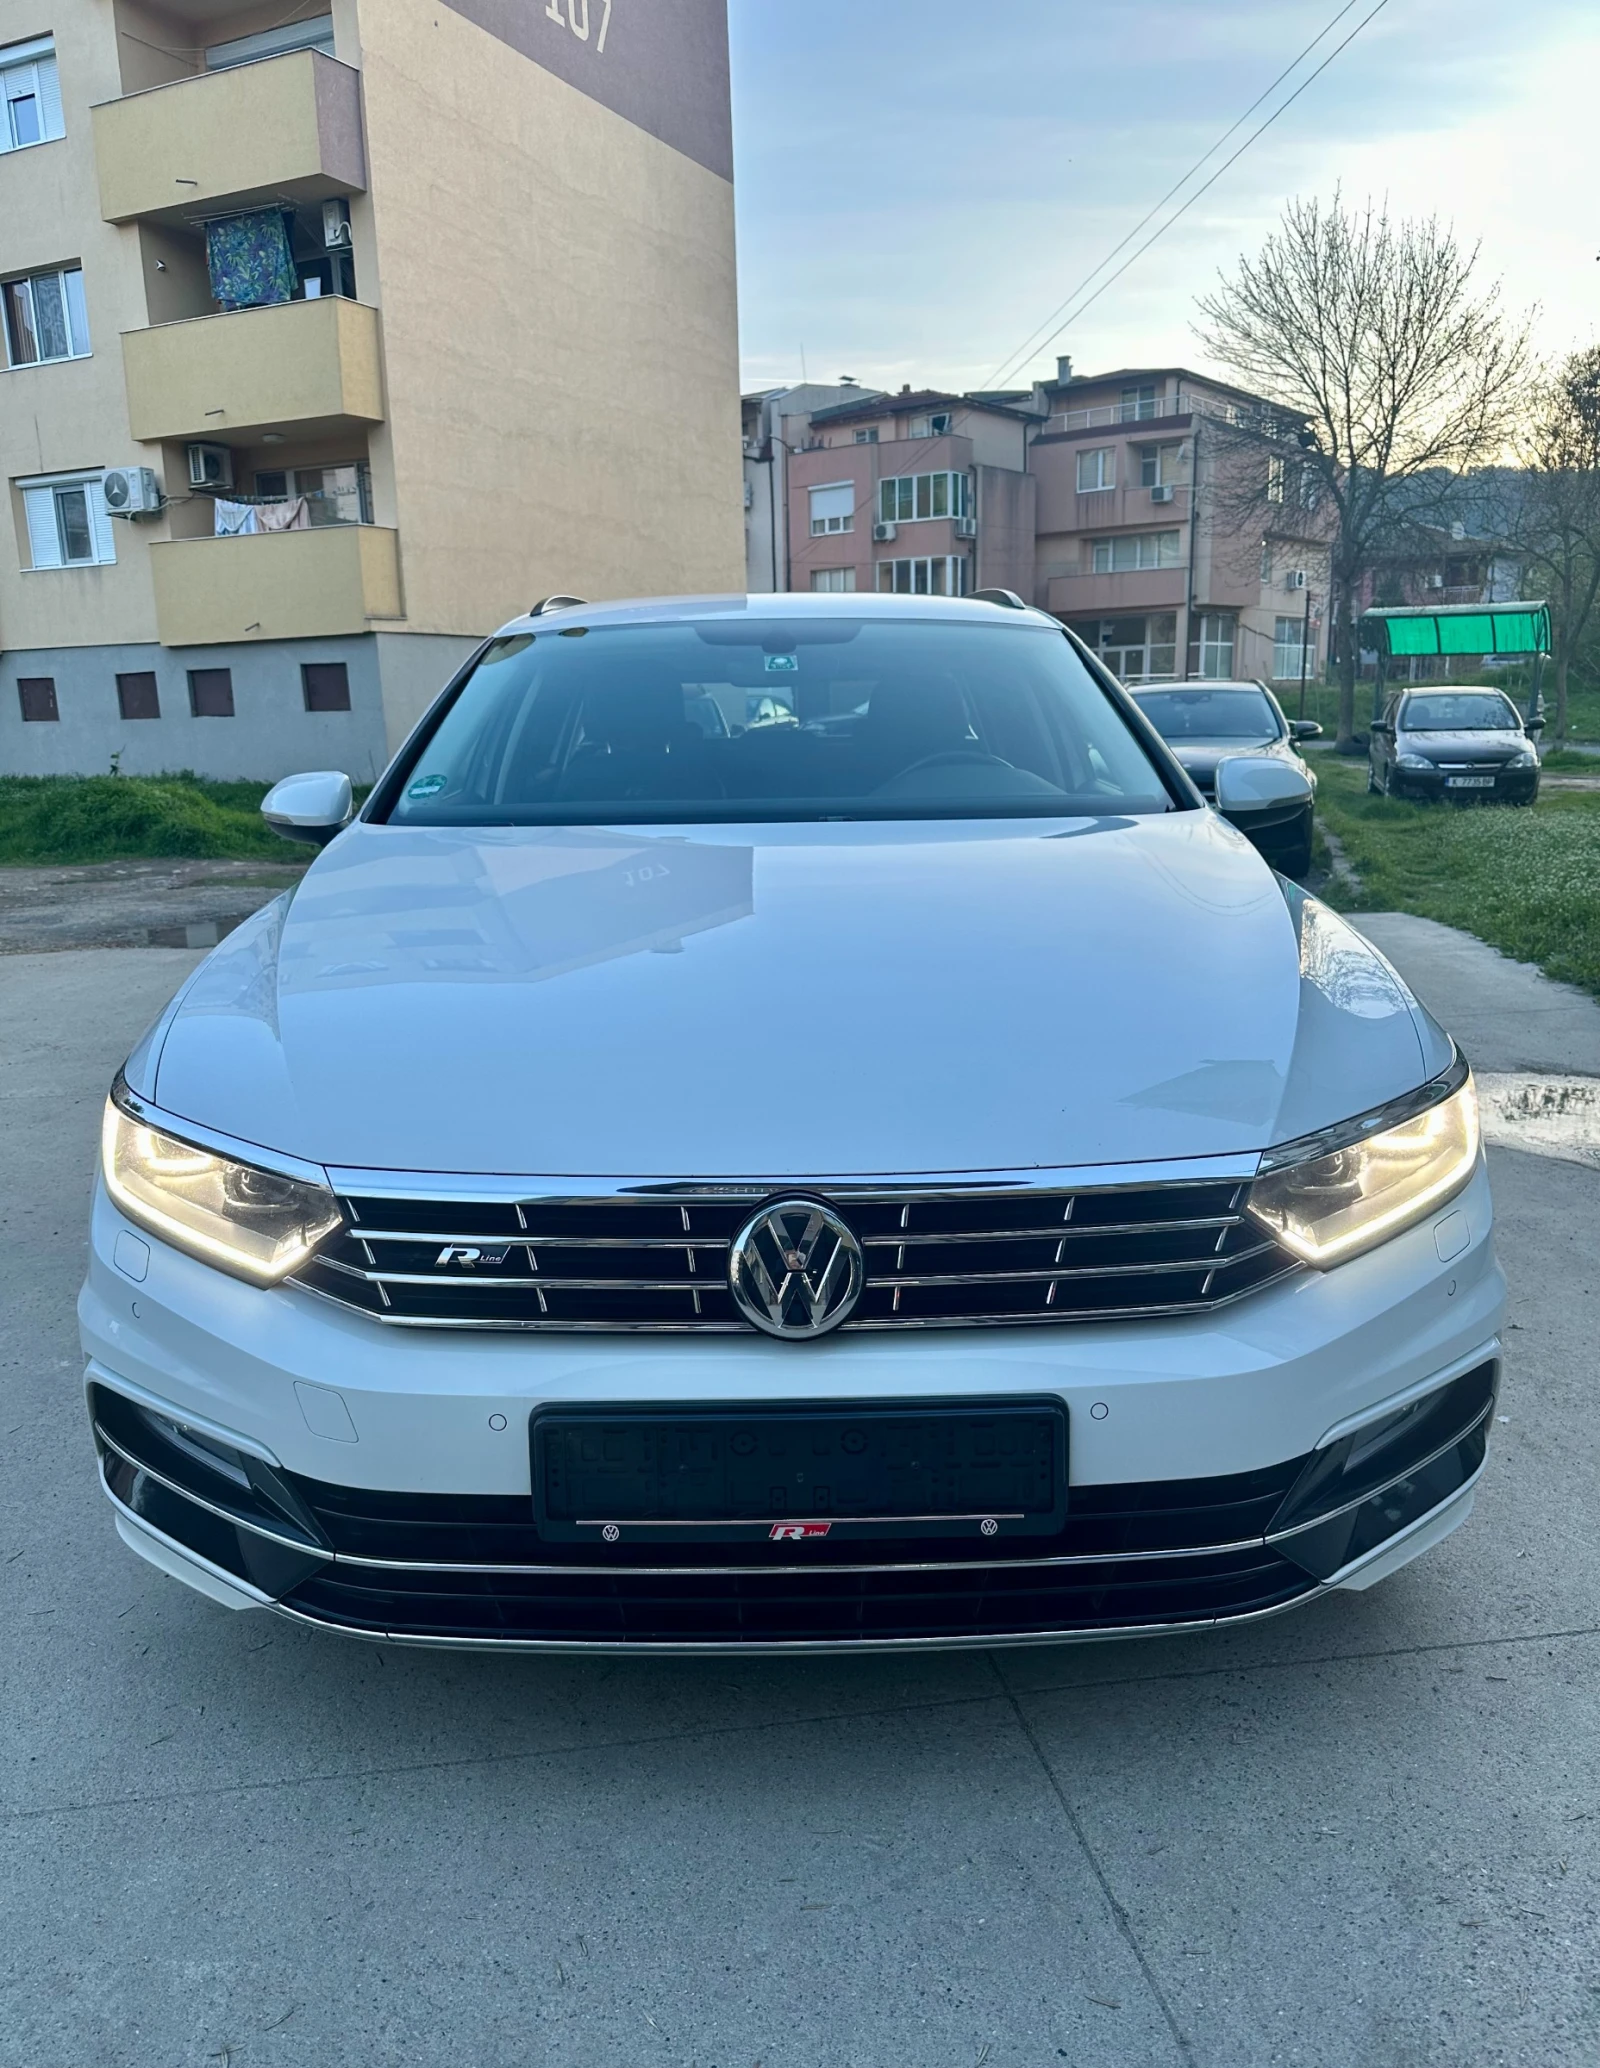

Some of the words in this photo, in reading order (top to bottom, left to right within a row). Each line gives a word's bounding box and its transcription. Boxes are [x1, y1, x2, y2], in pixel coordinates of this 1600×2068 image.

[434, 1247, 480, 1268] R
[479, 1254, 501, 1262] Line
[739, 1206, 855, 1333] VW
[603, 1525, 619, 1541] VW
[772, 1526, 805, 1540] R
[981, 1519, 997, 1535] VW
